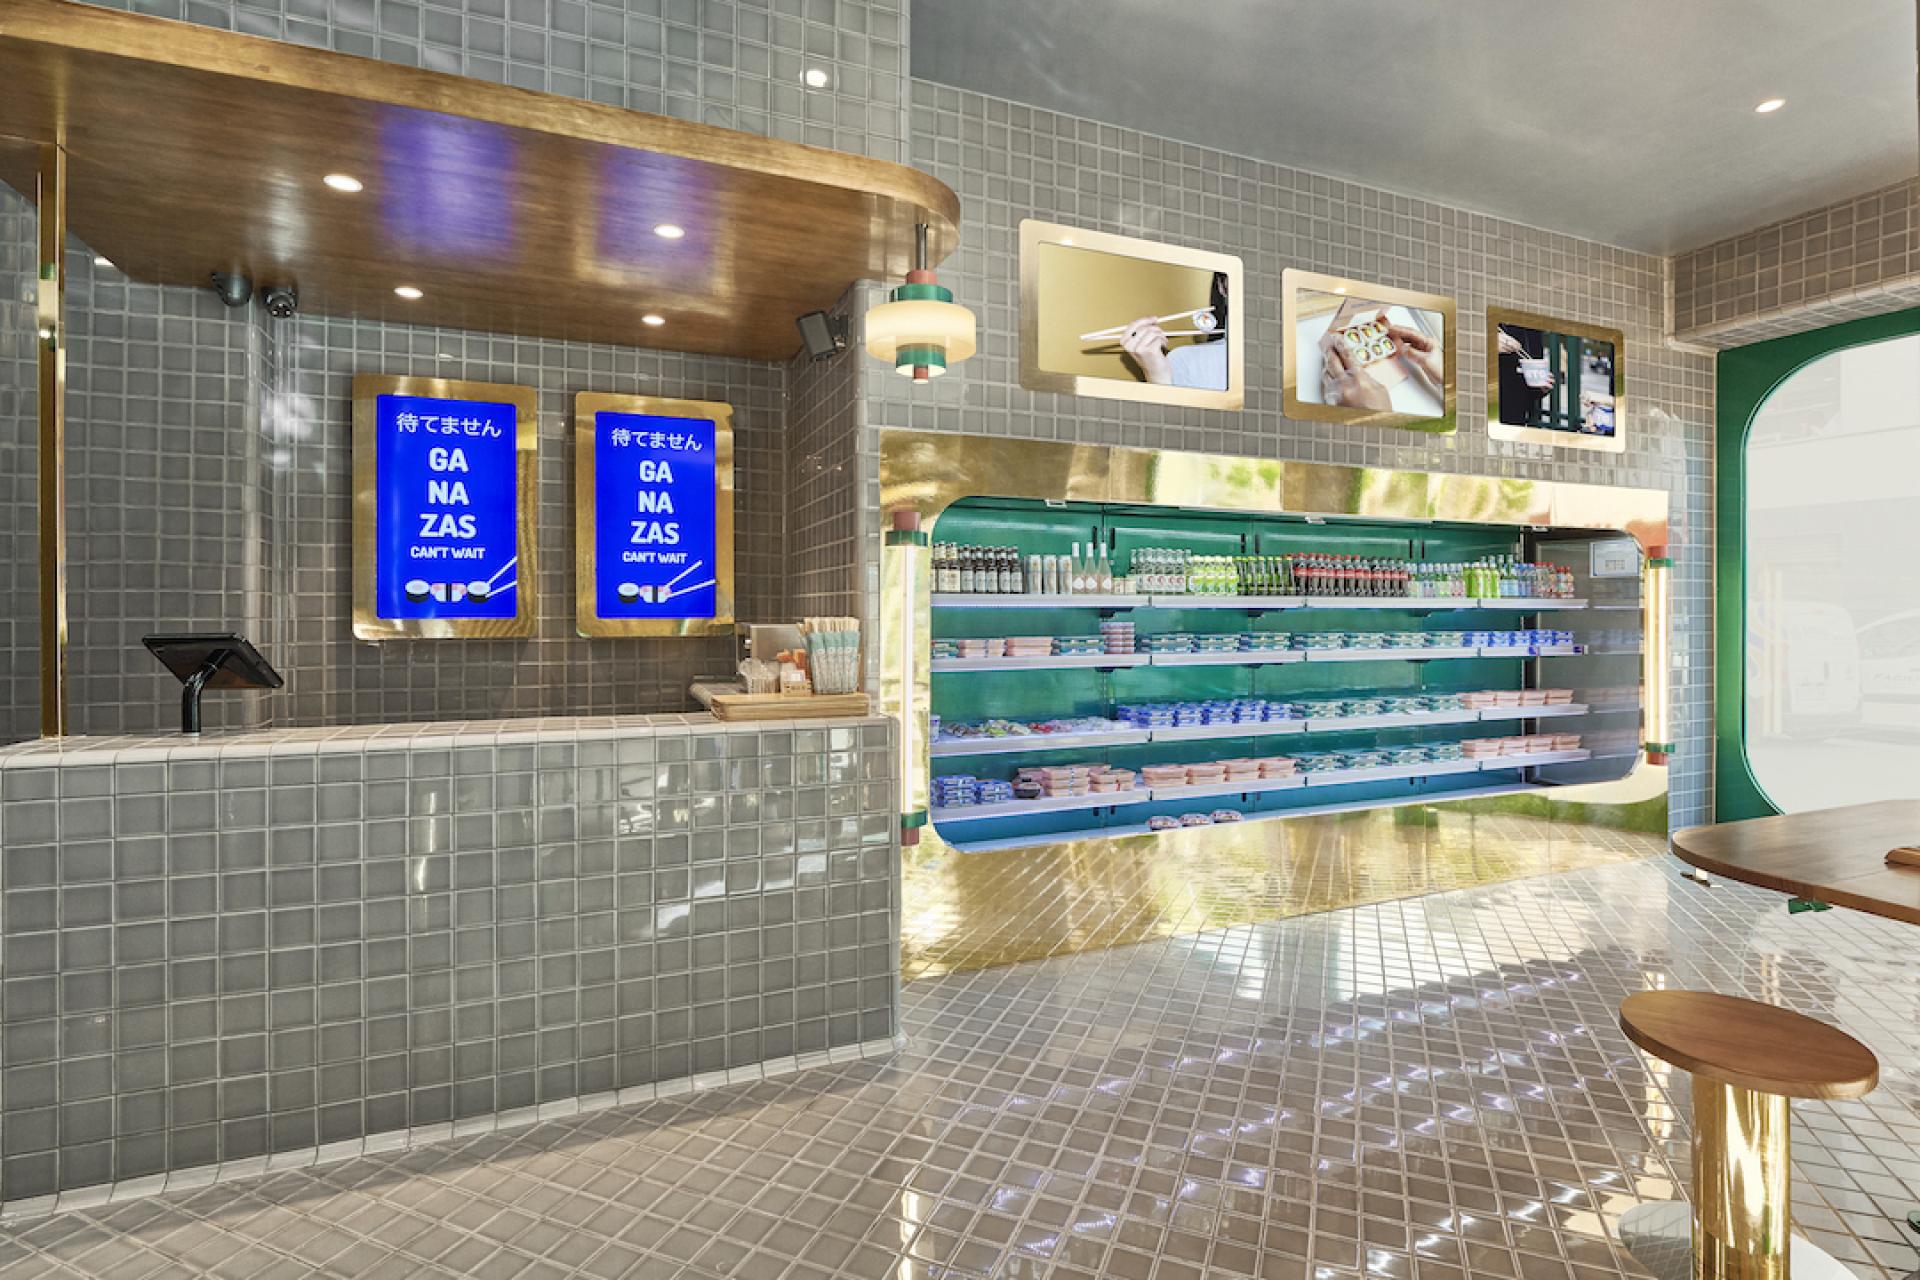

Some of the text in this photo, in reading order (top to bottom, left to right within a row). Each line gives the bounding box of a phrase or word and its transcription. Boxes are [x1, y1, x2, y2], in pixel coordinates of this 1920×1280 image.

[396, 412, 502, 438] 待てません
[611, 428, 703, 451] 待てません
[429, 447, 469, 472] GA
[639, 460, 674, 483] GA
[428, 480, 470, 505] NA
[638, 490, 674, 514] NA
[419, 513, 477, 539] ZAS
[630, 520, 680, 545] ZAS
[410, 546, 486, 559] CAN'T WAIT
[622, 551, 688, 564] CAN'T WAIT
